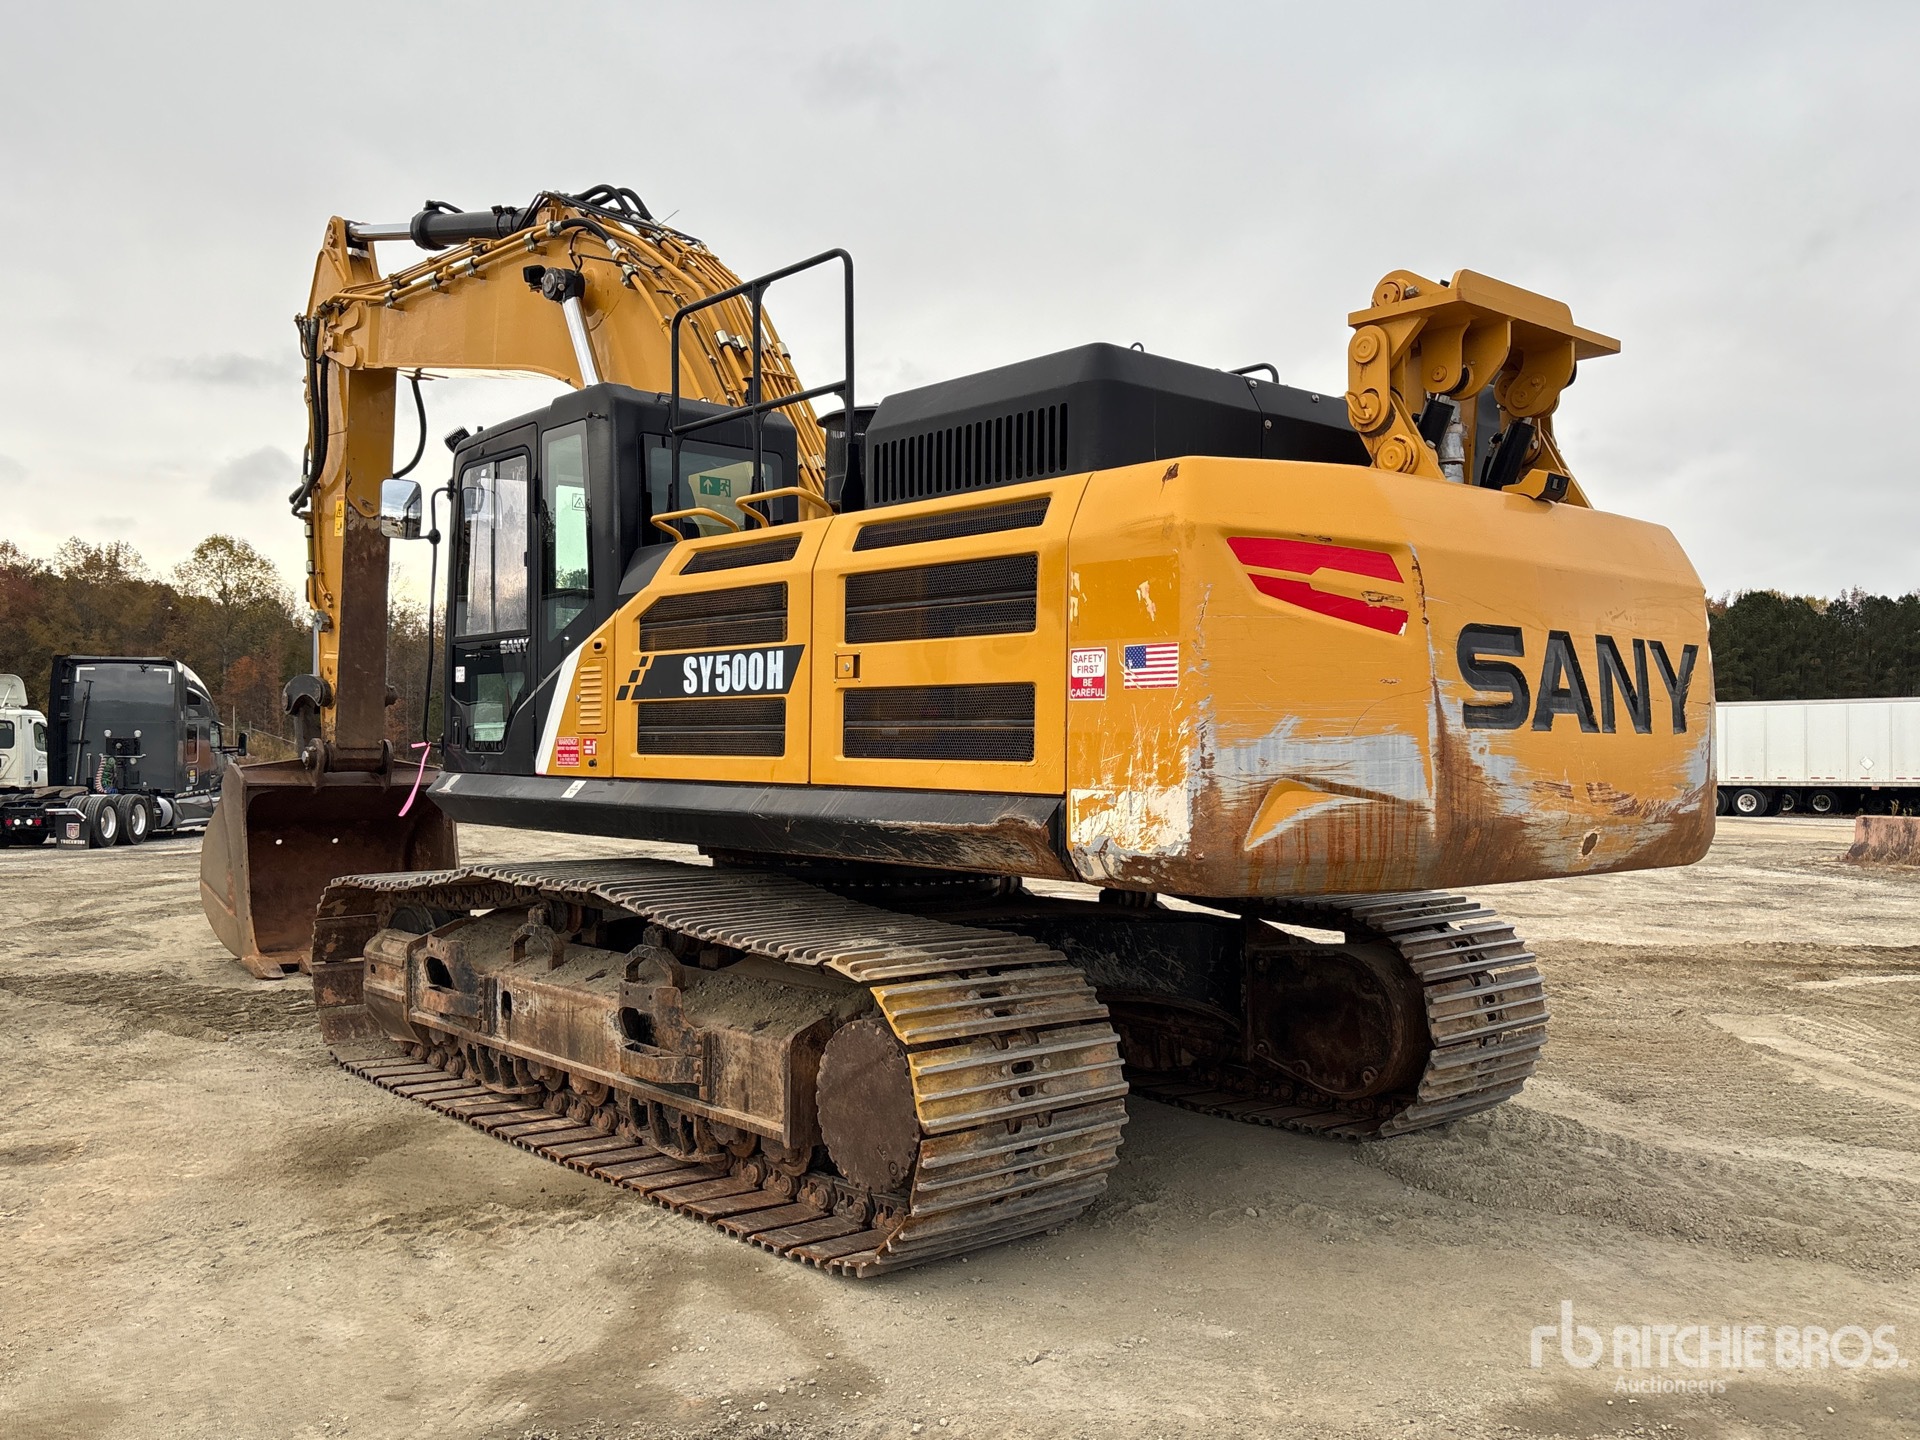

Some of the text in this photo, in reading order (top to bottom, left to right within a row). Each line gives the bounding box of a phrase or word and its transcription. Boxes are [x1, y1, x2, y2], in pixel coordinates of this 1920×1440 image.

[499, 637, 530, 655] SANY
[1073, 654, 1103, 663] SAFETY
[683, 650, 784, 694] SY500H
[1077, 665, 1099, 673] FIRST
[1082, 678, 1093, 687] BE
[1457, 622, 1699, 734] SANY
[1071, 688, 1105, 697] CAREFUL
